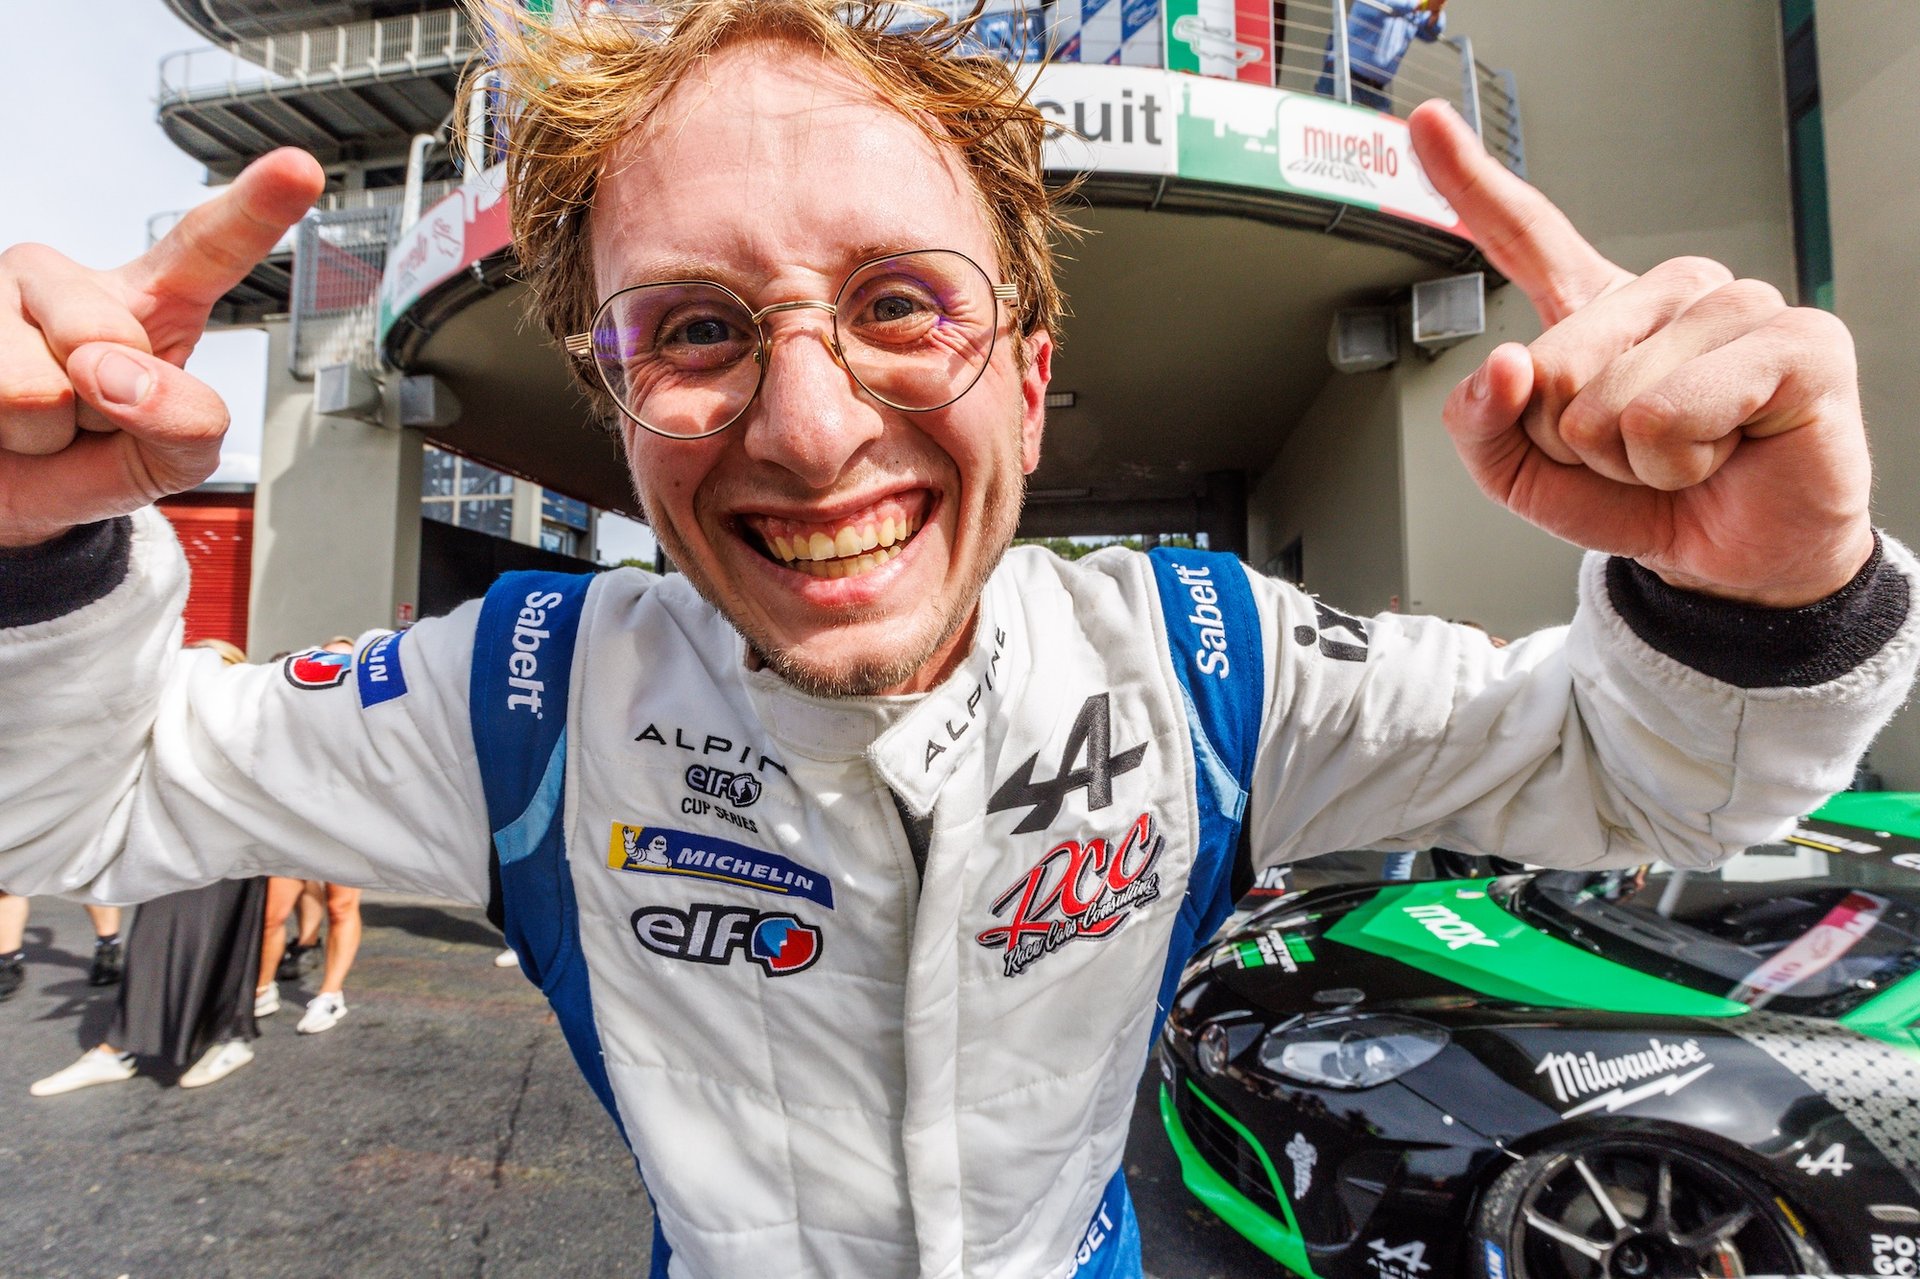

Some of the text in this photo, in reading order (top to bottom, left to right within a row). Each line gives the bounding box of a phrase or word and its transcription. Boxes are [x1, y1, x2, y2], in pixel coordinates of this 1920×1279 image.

[1304, 126, 1398, 177] mugello
[1175, 565, 1230, 680] Sabelt
[507, 590, 563, 716] Sabelt
[925, 627, 1006, 774] ALPINE
[686, 765, 733, 798] elf
[681, 797, 759, 833] CUP SERIES
[677, 847, 815, 891] MICHELIN
[634, 908, 753, 961] elf
[1045, 919, 1079, 949] Cars
[1082, 873, 1160, 930] Consulting
[1534, 1038, 1706, 1103] Milwaukee
